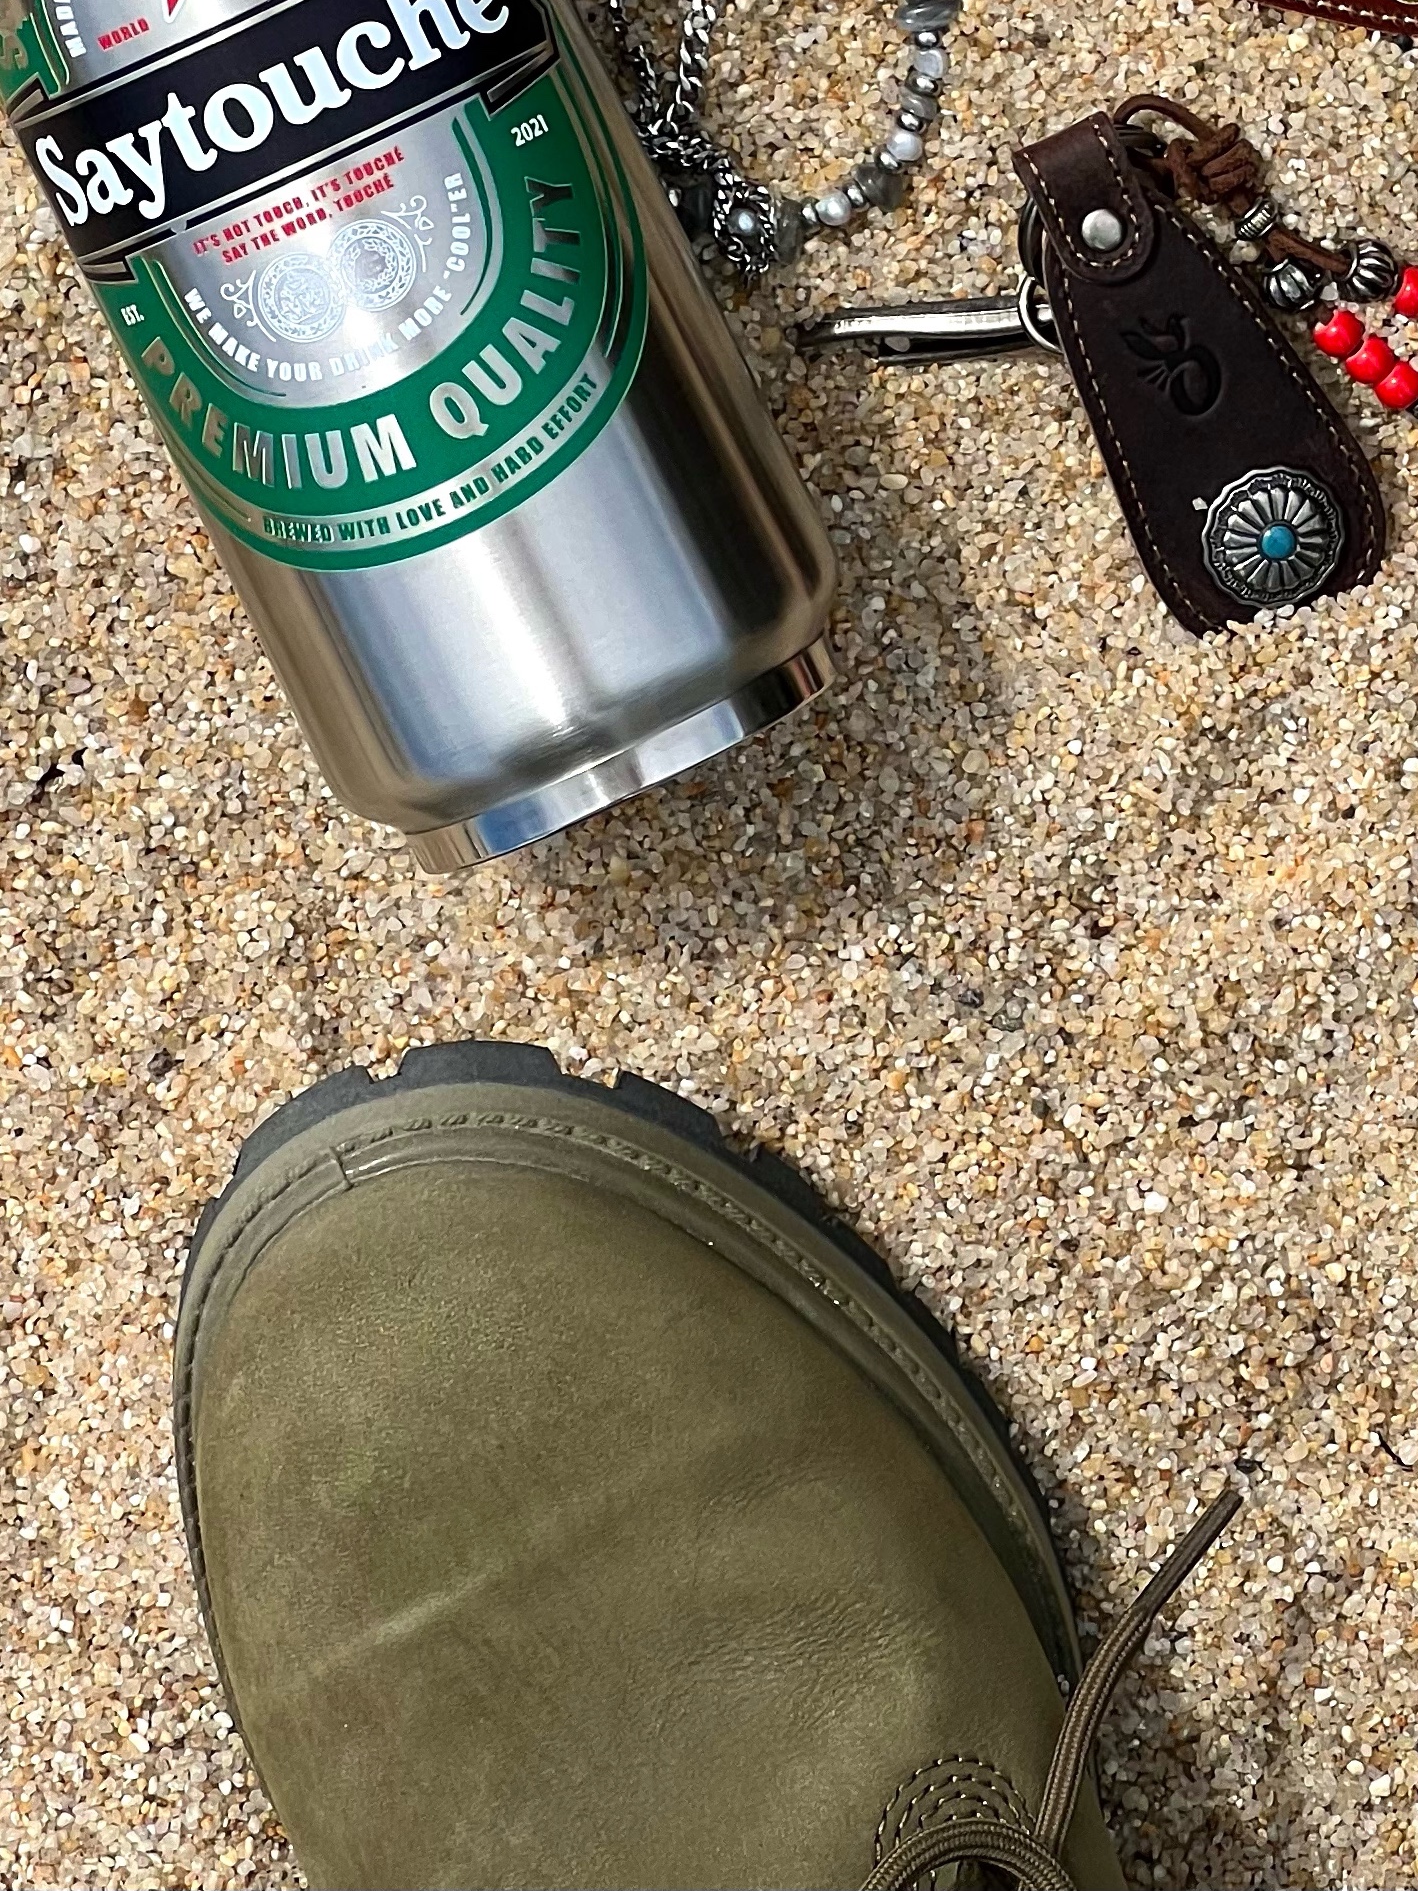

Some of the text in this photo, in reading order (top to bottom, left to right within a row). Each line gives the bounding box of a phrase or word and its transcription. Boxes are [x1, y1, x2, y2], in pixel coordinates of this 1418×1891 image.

[97, 17, 151, 52] WORLD
[510, 114, 549, 147] 2021
[192, 233, 222, 256] IT'S
[222, 219, 252, 242] NOT
[310, 178, 342, 202] IT'S
[343, 144, 405, 186] TOUCHÉ
[221, 242, 248, 265] SAY
[251, 228, 280, 251] THE
[332, 172, 395, 213] TOUCHÉ
[120, 304, 145, 327] EST.
[140, 175, 582, 490] PREMIUM QUALITY
[183, 287, 212, 325] WE
[207, 322, 262, 374] MAKE
[265, 357, 324, 383] YOUR
[398, 284, 452, 341] MORE
[262, 372, 598, 544] BREWED WITH LOVE AND HARD EFFORT
